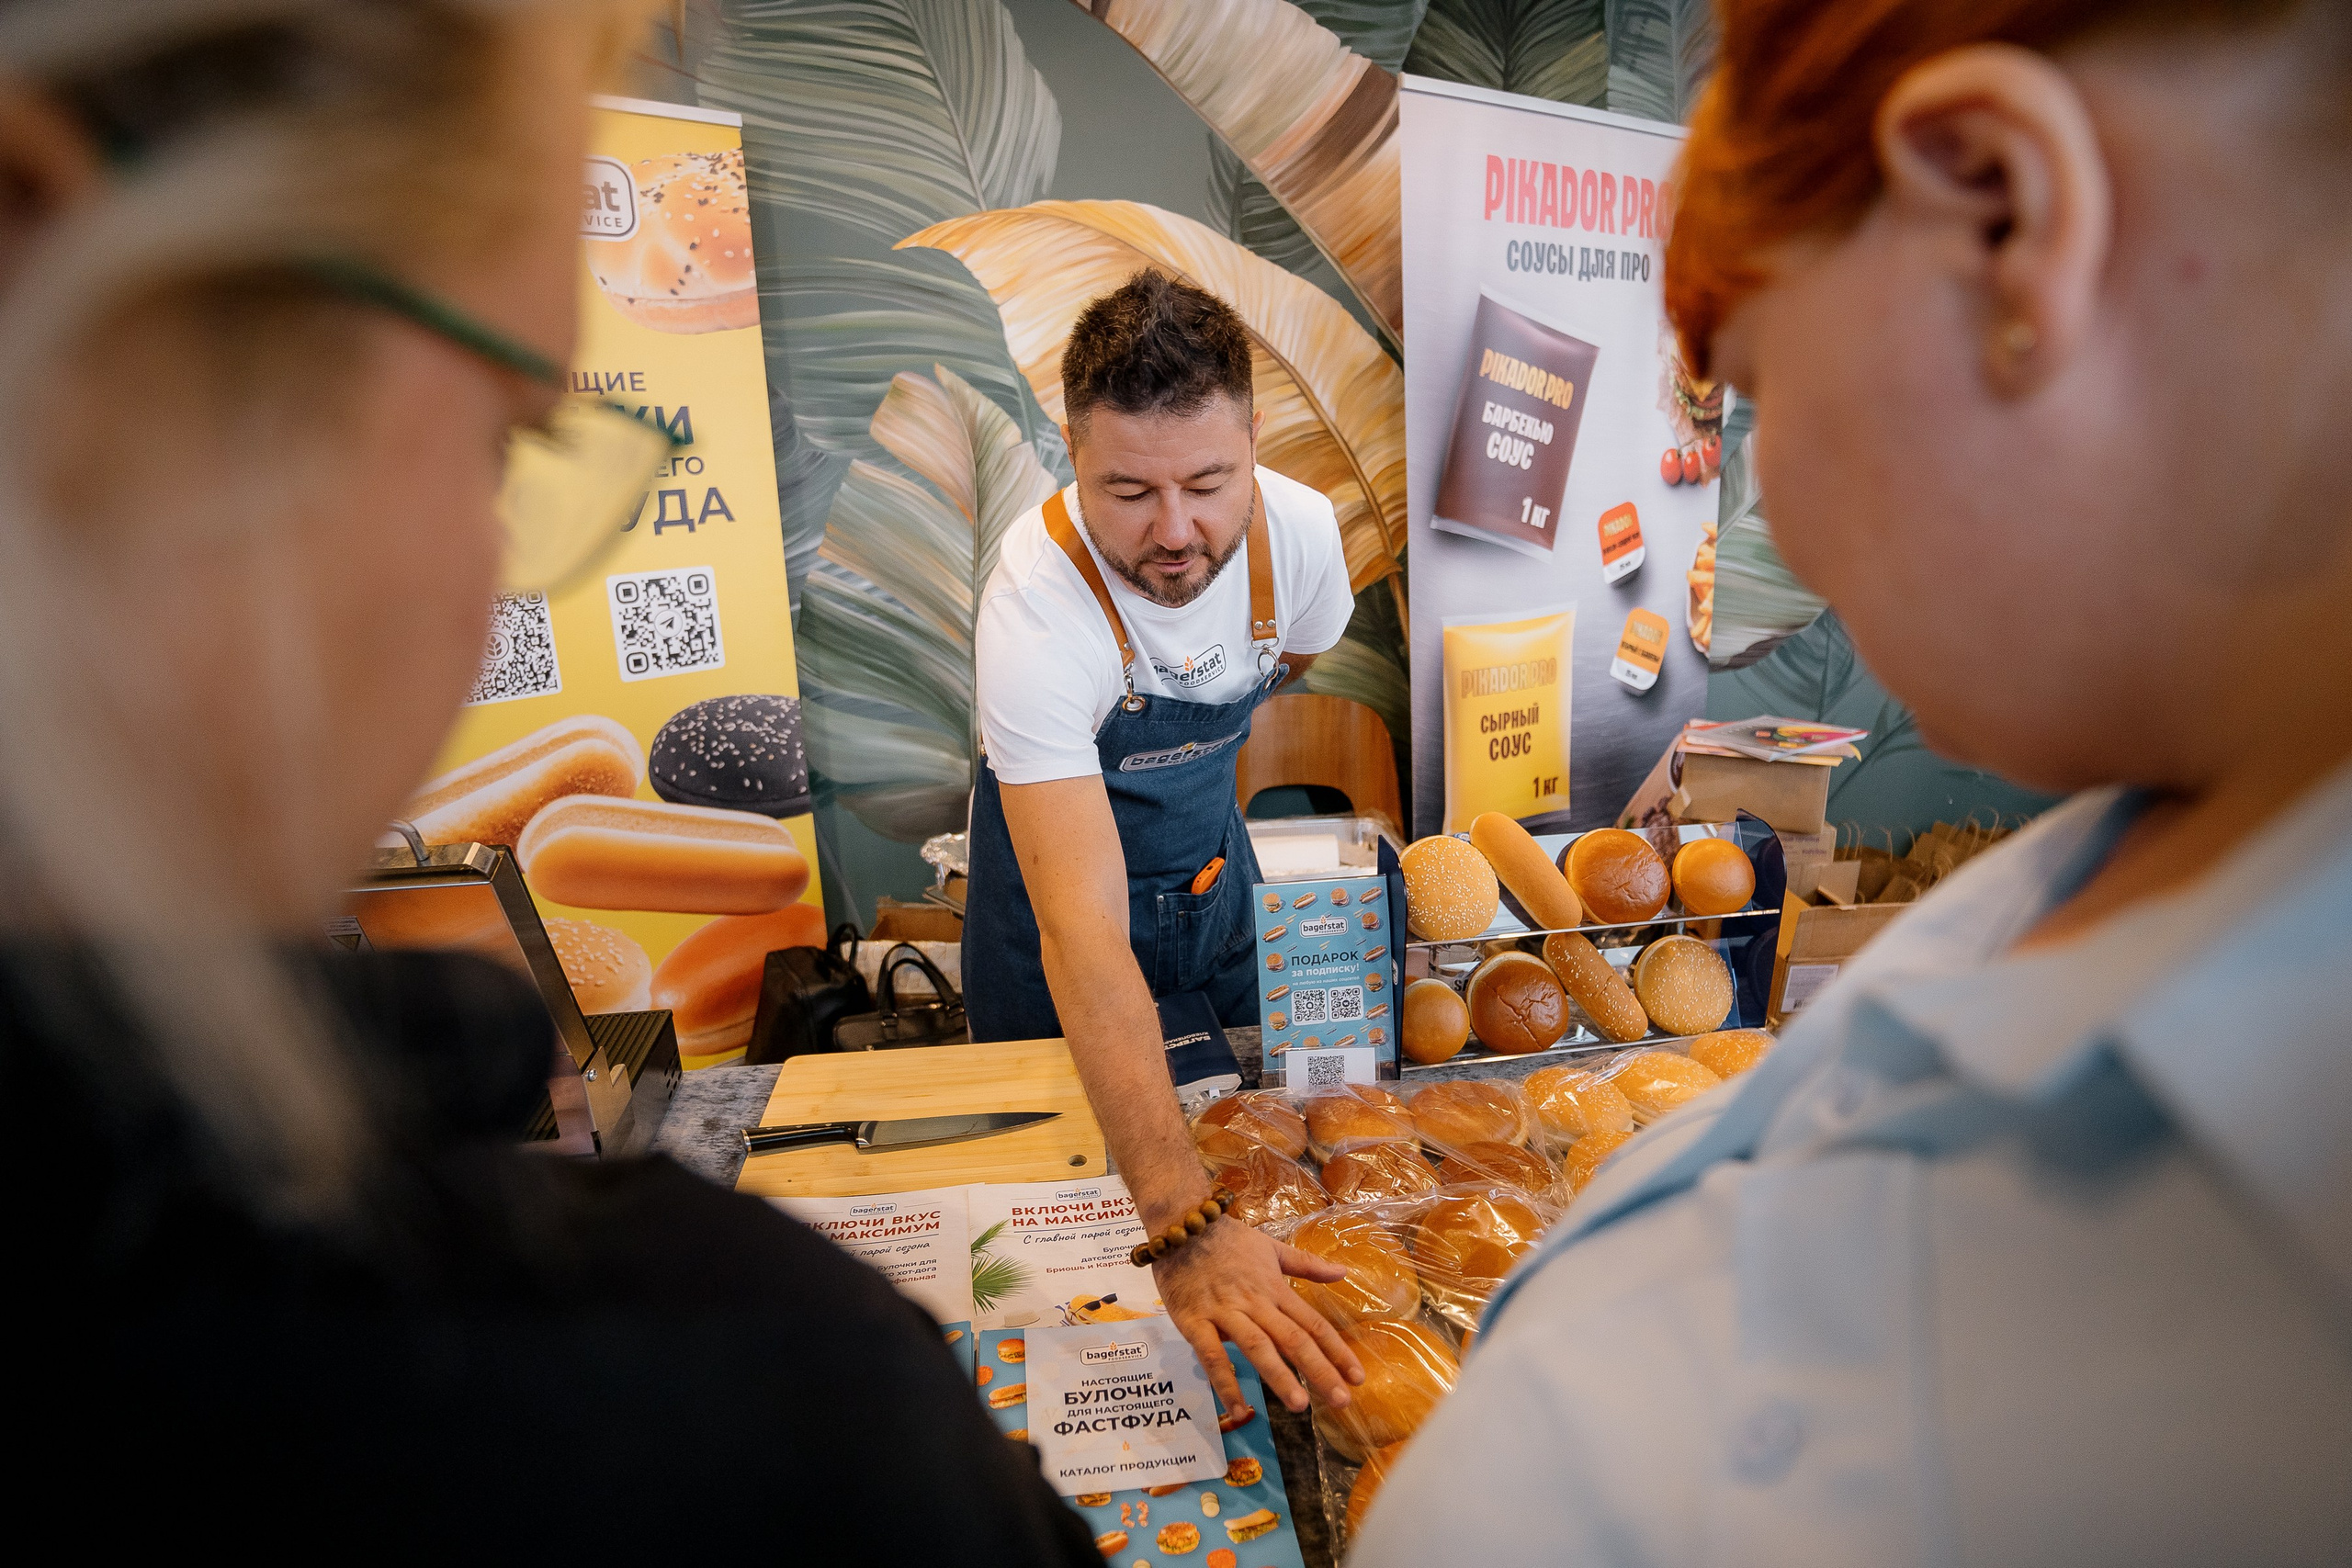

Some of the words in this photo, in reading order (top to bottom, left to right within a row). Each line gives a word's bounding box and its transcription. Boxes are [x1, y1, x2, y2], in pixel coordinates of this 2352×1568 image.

[582, 182, 620, 211] at
[1485, 154, 1617, 235] PIKADOR
[1621, 175, 1675, 240] PRO
[584, 215, 623, 227] VICE
[1507, 240, 1574, 276] СОУСЫ
[1578, 247, 1615, 282] ДЛЯ
[1621, 251, 1650, 283] ПРО
[566, 371, 647, 395] ЩИЕ
[1478, 348, 1548, 400] PIKADOR
[1487, 431, 1535, 470] СОУС
[620, 487, 736, 536] УДА
[1521, 496, 1532, 524] 1
[1179, 665, 1224, 685] FOODSERVICE
[1461, 662, 1528, 699] PIKADOR
[1530, 658, 1557, 689] PRO
[1480, 702, 1540, 733] СЫРНЫЙ
[1489, 731, 1532, 761] СОУС
[1533, 776, 1540, 798] 1
[1544, 777, 1559, 795] кг
[1303, 922, 1344, 932] bagerstat
[1291, 951, 1359, 966] ПОДАРОК
[1292, 969, 1304, 977] за
[1306, 963, 1360, 976] подписку!
[1164, 1035, 1212, 1051] БАГЕРСТ
[1057, 1190, 1098, 1198] bagerstat
[853, 1205, 894, 1213] bagerstat
[1012, 1202, 1093, 1216] ВКЛЮЧИ
[1102, 1197, 1135, 1208] ВКУ
[892, 1211, 941, 1225] ВКУС
[1012, 1217, 1038, 1227] НА
[1045, 1207, 1136, 1225] МАКСИМУ
[830, 1221, 940, 1241] МАКСИМУМ
[1023, 1235, 1032, 1245] С
[1035, 1233, 1076, 1244] главной
[1080, 1229, 1111, 1240] парой
[860, 1246, 892, 1258] парой
[896, 1242, 930, 1255] сезона
[1080, 1253, 1123, 1263] датского
[876, 1261, 917, 1272] Булочки
[919, 1258, 937, 1267] для
[897, 1266, 937, 1277] хот-дога
[1046, 1265, 1085, 1274] Бриошь
[1095, 1259, 1132, 1269] Картоф
[890, 1274, 936, 1285] фельная
[1086, 1347, 1142, 1359] bagerstat
[1081, 1372, 1153, 1387] НАСТОЯЩИЕ
[1064, 1381, 1174, 1405] БУЛОЧКИ
[1067, 1408, 1091, 1418] ДЛЯ
[1095, 1398, 1174, 1415] НАСТОЯЩЕГО
[1053, 1407, 1193, 1436] ФАСТФУДА
[1059, 1464, 1115, 1478] КАТАЛОГ
[1120, 1454, 1197, 1472] ПРОДУКЦИИ
